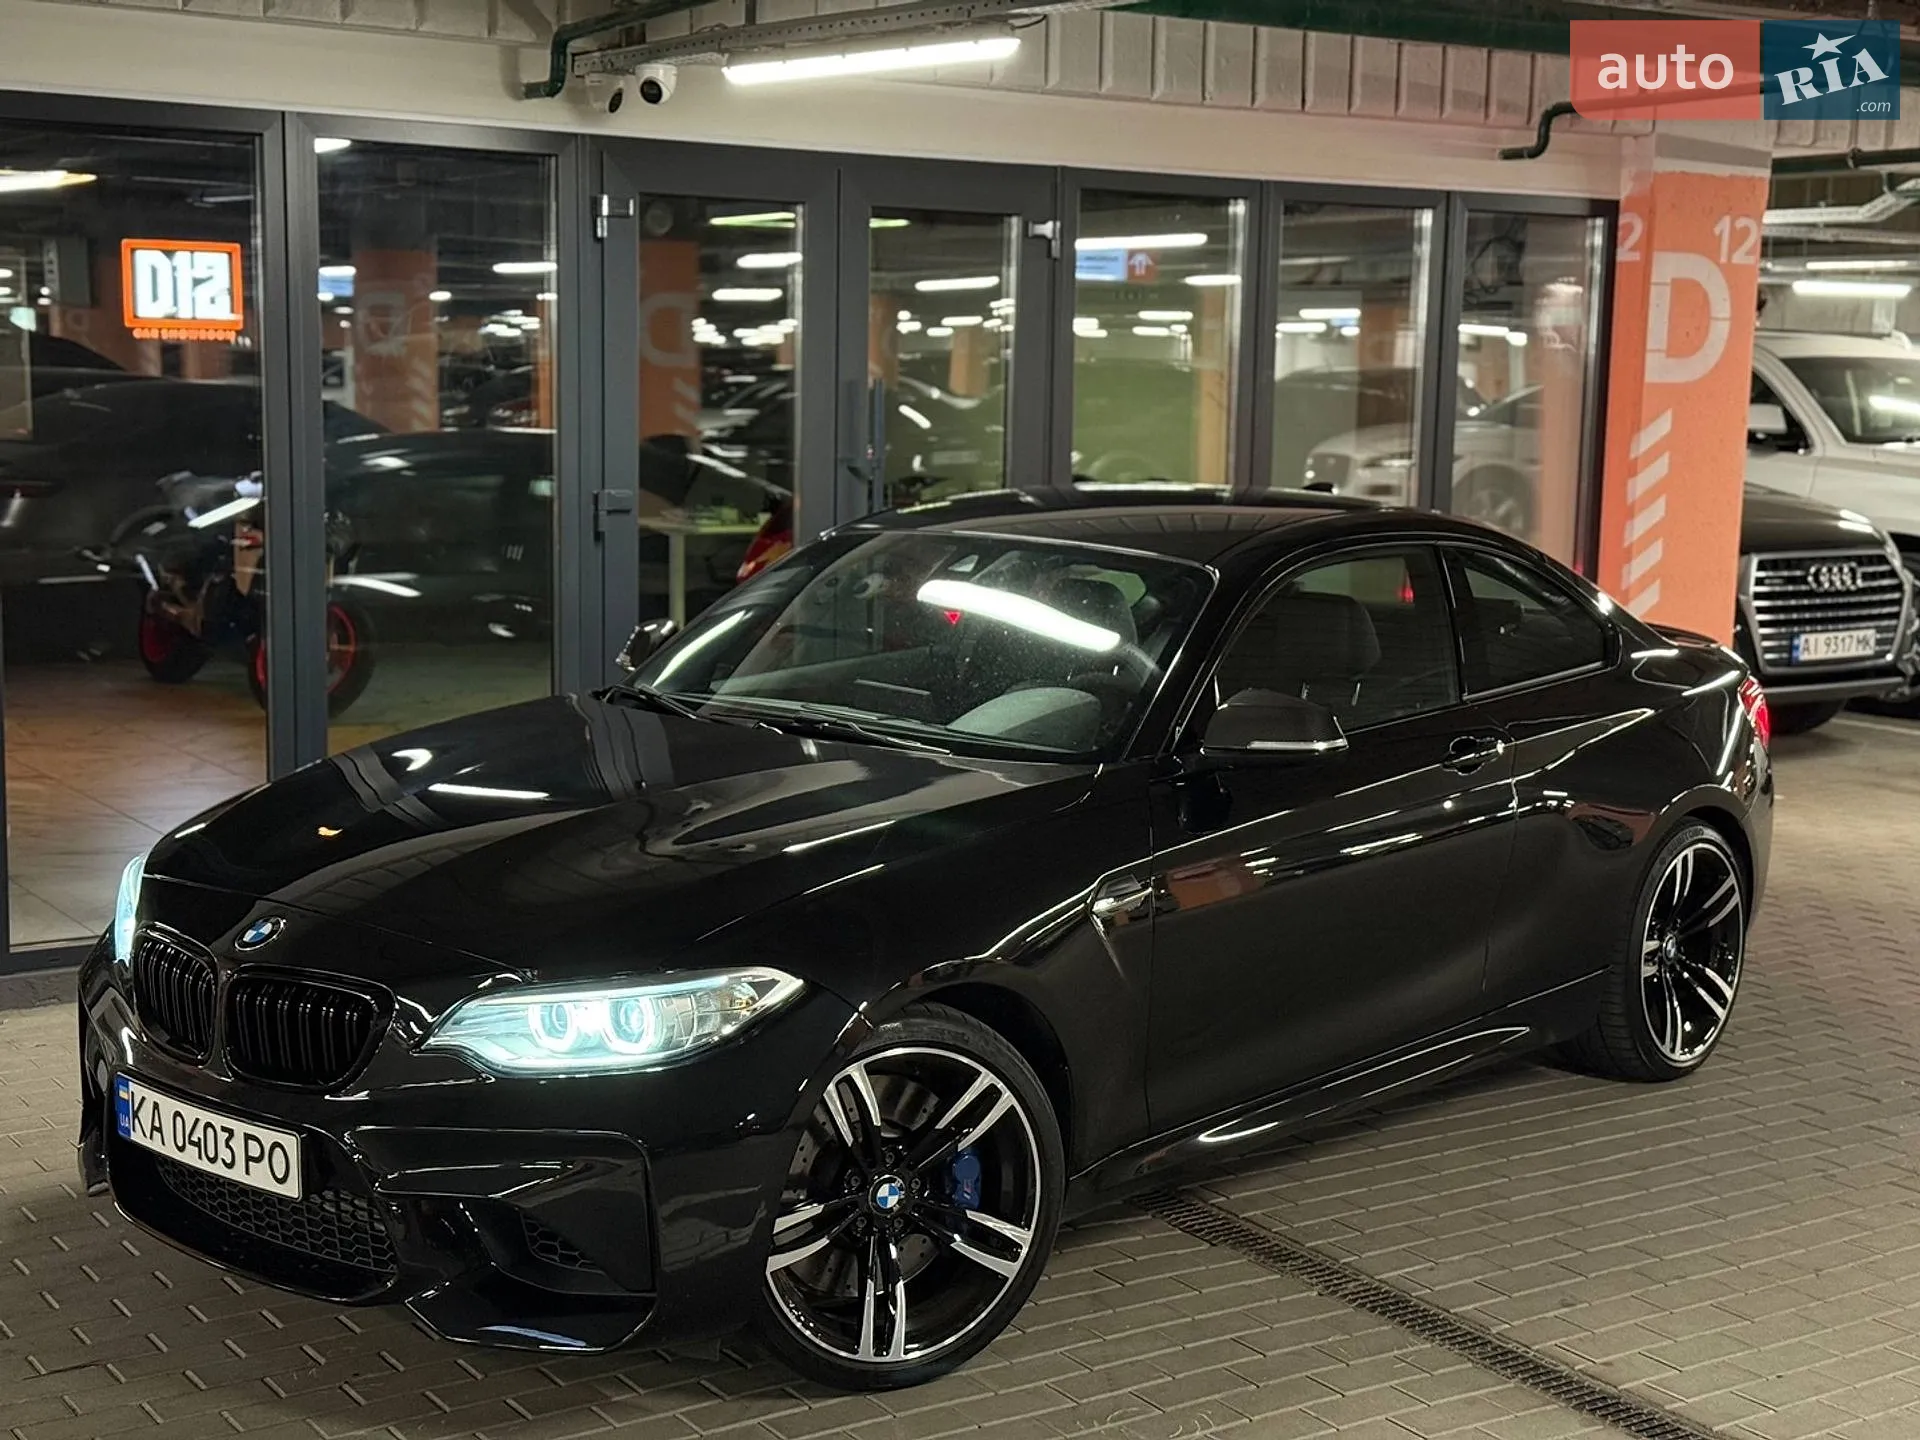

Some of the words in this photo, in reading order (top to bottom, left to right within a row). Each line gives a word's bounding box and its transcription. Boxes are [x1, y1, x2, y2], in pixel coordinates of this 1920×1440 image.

[1713, 215, 1760, 264] 12
[133, 249, 242, 320] D12
[1644, 251, 1732, 384] D
[119, 1112, 130, 1128] UA
[131, 1090, 165, 1146] KA
[173, 1110, 236, 1169] 0403
[243, 1131, 291, 1184] PO
